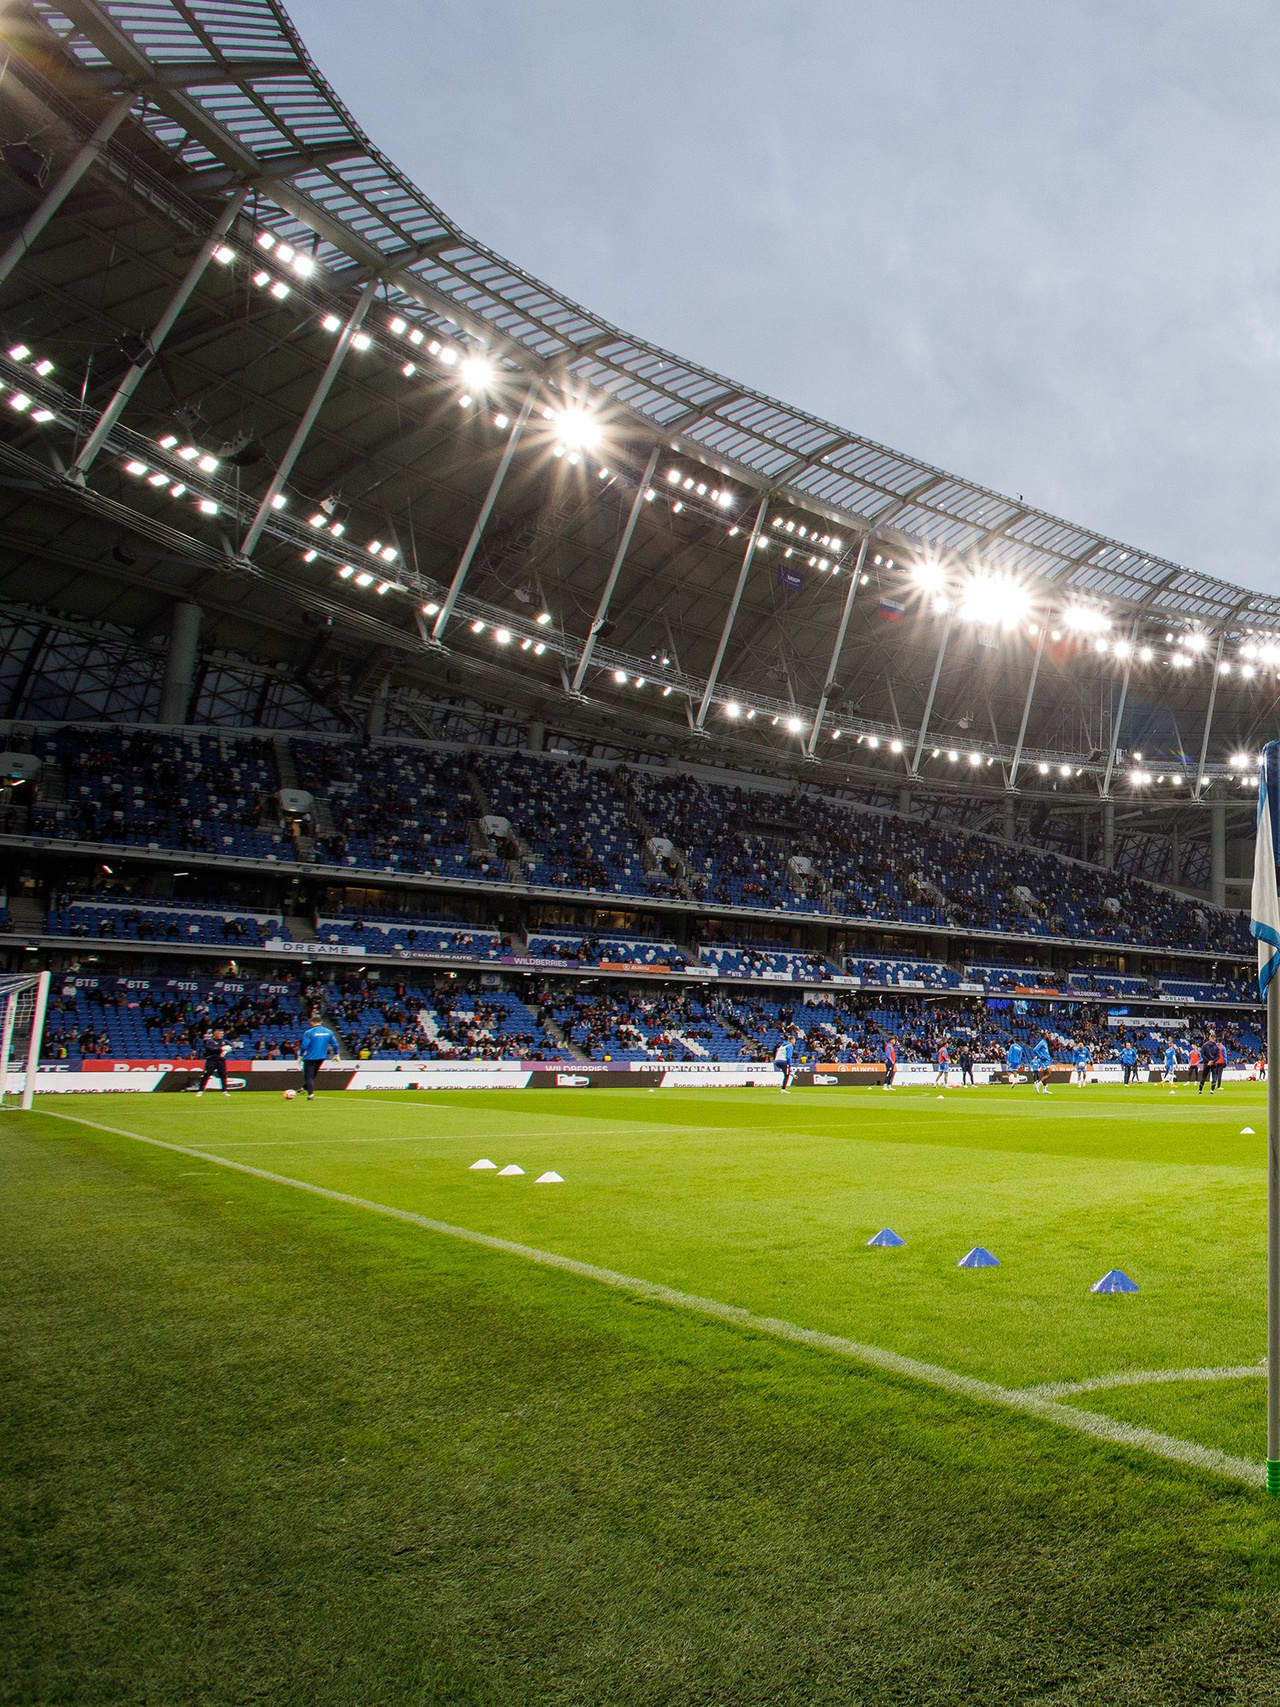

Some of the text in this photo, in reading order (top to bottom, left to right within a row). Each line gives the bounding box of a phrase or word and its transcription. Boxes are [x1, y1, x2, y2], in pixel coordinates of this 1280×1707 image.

[283, 943, 349, 954] DREAME
[513, 957, 568, 967] WILDBERRIES
[75, 978, 98, 987] ВТБ
[127, 980, 149, 989] ВТБ
[223, 983, 244, 992] ВТБ
[268, 985, 288, 994] ВТБ
